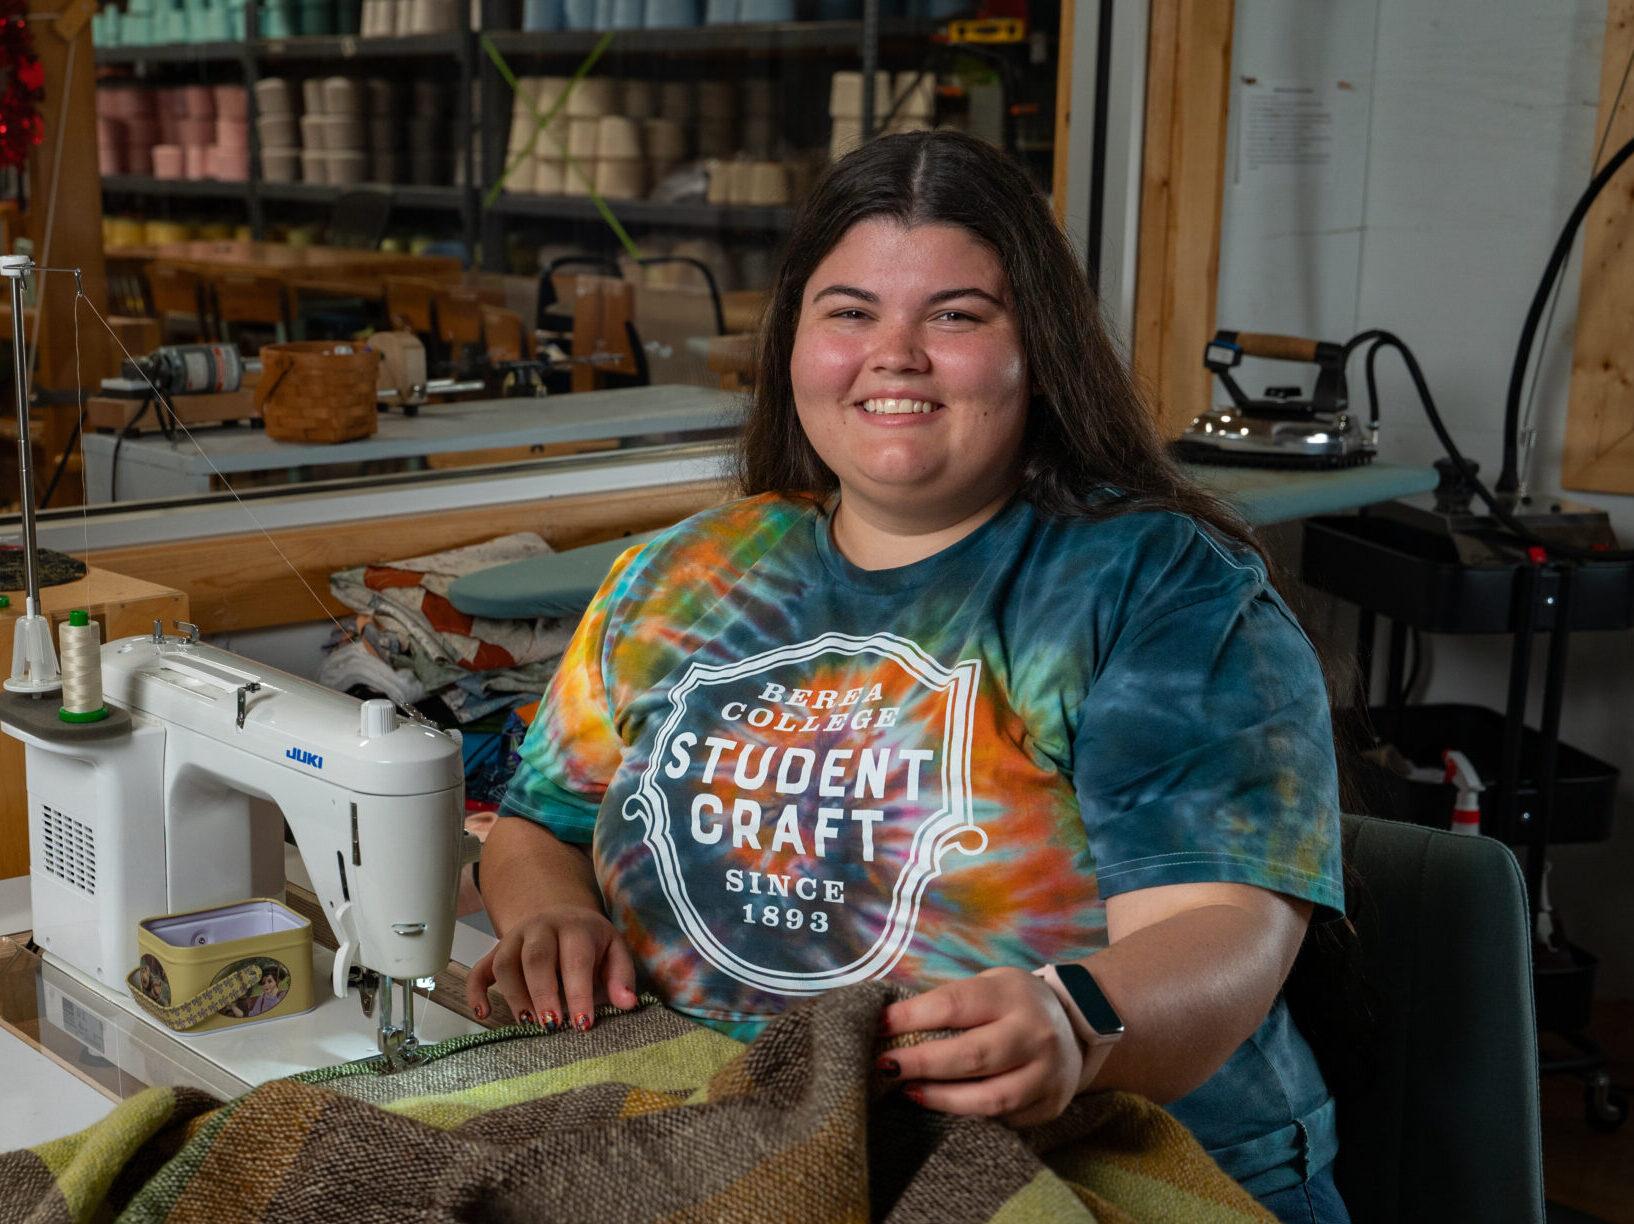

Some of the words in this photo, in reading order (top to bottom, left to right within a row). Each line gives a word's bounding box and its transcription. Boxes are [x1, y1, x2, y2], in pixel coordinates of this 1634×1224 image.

[758, 682, 883, 710] BEREA
[720, 702, 899, 733] COLLEGE
[286, 747, 323, 769] JUKI
[665, 731, 934, 801] STUDENT
[690, 794, 884, 862] CRAFT
[725, 869, 846, 904] SINCE
[742, 904, 830, 933] 1893
